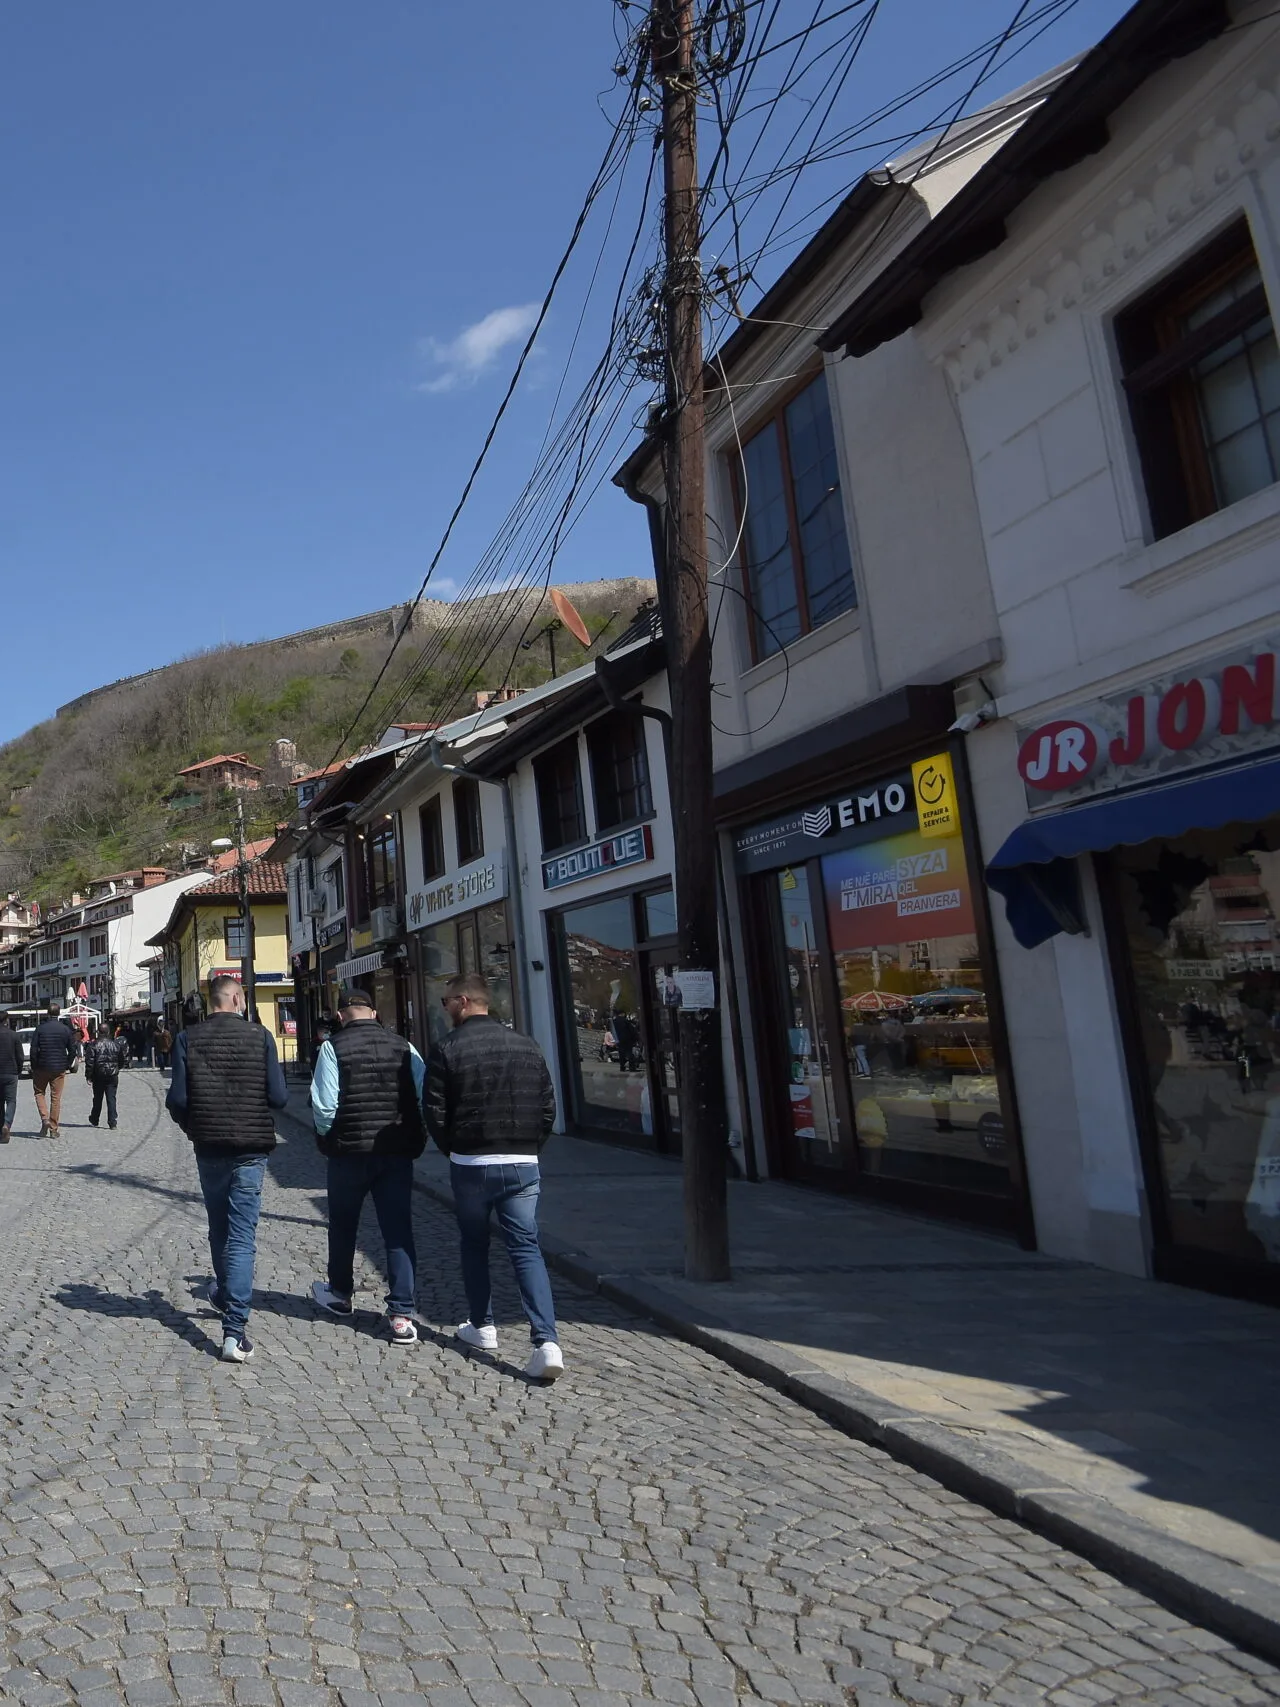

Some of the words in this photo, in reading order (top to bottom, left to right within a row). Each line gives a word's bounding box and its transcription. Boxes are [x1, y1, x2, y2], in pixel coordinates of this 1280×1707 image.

[1026, 726, 1087, 781] JR
[837, 783, 906, 829] EMO
[923, 807, 943, 818] REPAIR
[924, 815, 950, 828] SERVICE
[736, 835, 758, 848] EVERY
[759, 823, 790, 840] MOMENT
[557, 833, 640, 880] BOUTIQUE
[753, 845, 770, 856] SINCE
[840, 879, 853, 890] ME
[855, 872, 872, 887] NJË
[872, 865, 897, 884] PARË
[898, 852, 944, 878] SYZA
[426, 882, 454, 914] WHITE
[457, 864, 495, 902] STORE
[897, 881, 918, 895] QEL
[900, 892, 959, 913] PRANVERA
